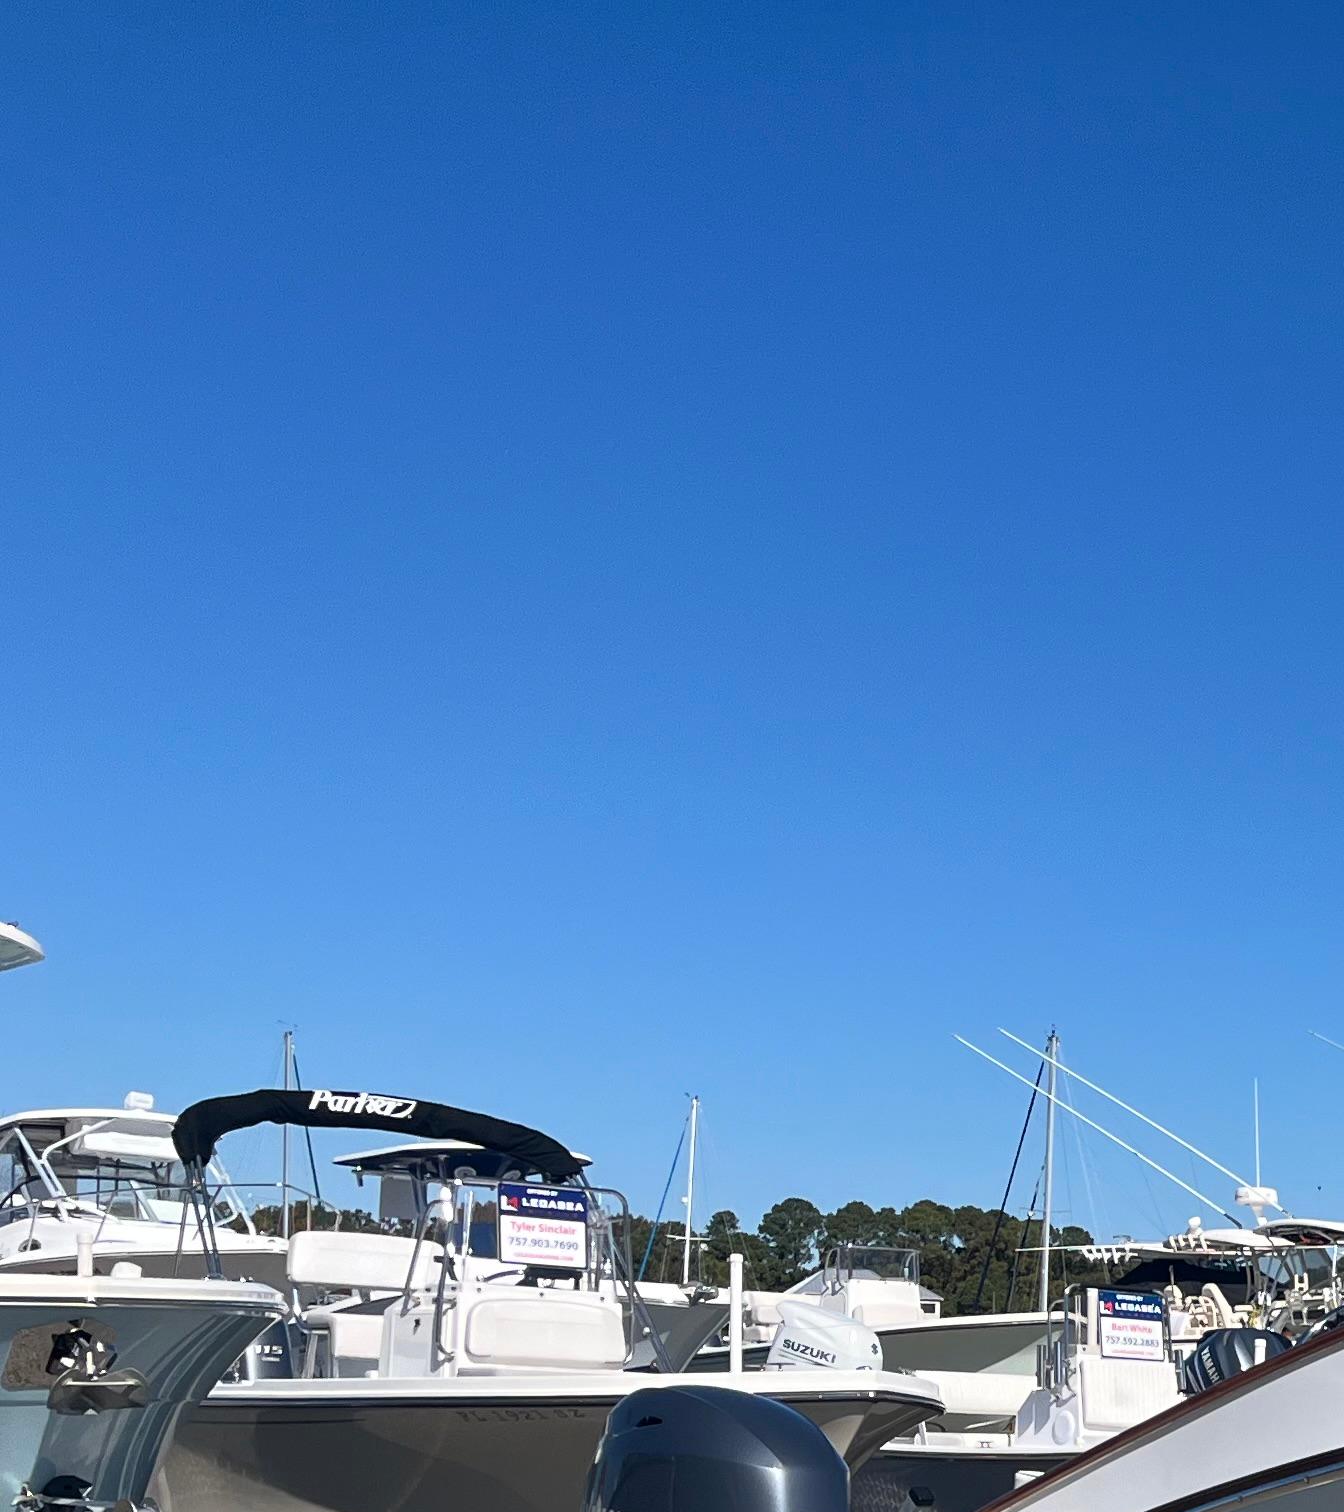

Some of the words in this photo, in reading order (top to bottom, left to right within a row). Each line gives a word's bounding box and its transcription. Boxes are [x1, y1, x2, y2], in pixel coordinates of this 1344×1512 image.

[308, 1089, 412, 1118] Parker
[510, 1221, 535, 1233] Tyler
[538, 1223, 577, 1235] Sinclair
[508, 1236, 579, 1250] 757.903.7690
[782, 1339, 836, 1364] SUZUKI
[1201, 1345, 1220, 1383] YAMAH
